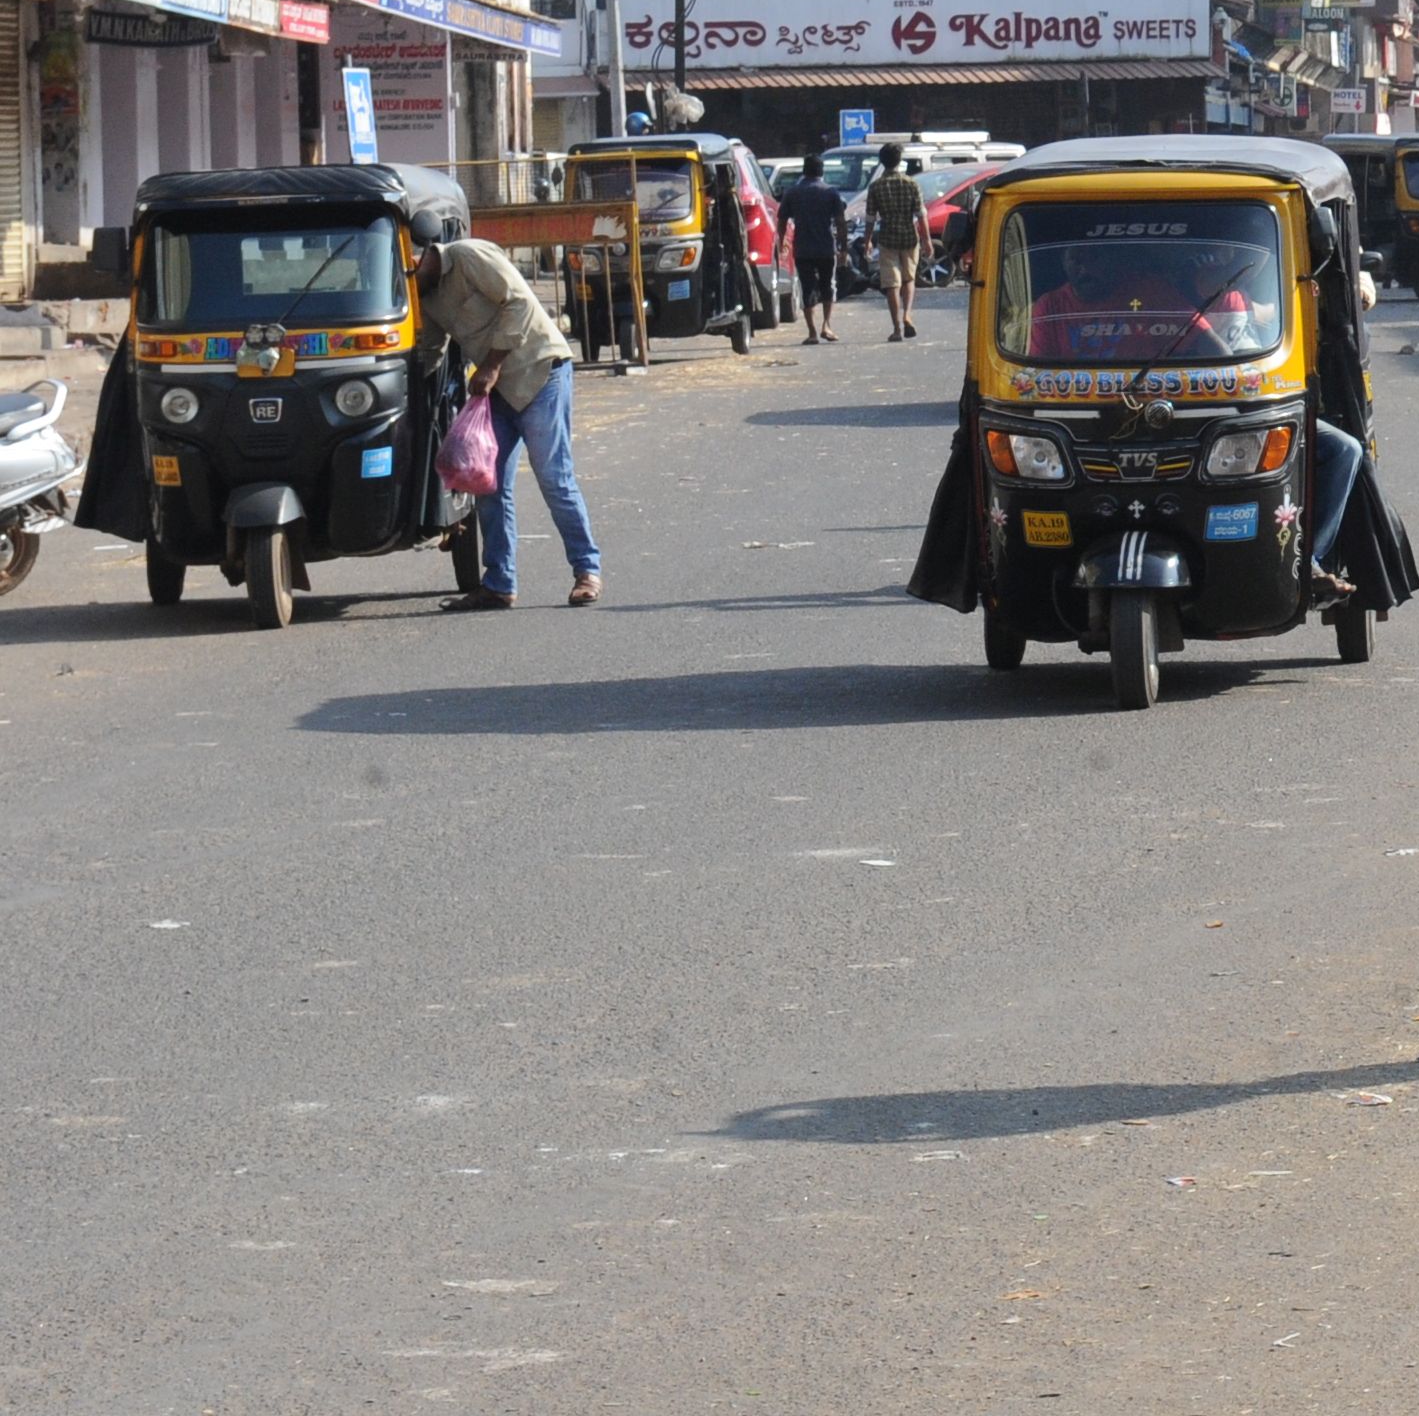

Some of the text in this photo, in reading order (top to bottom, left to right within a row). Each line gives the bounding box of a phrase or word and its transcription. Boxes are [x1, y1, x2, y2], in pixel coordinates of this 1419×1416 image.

[1311, 8, 1345, 20] ALOON
[949, 11, 1102, 51] Kalpana
[1113, 19, 1197, 40] SWEETS
[1333, 92, 1363, 100] HOTEL
[1086, 223, 1189, 237] JESUS
[1080, 323, 1187, 338] SHAOM
[1035, 367, 1238, 396] GOD BLESS YOU
[256, 406, 276, 419] RE
[1118, 453, 1159, 467] TVS
